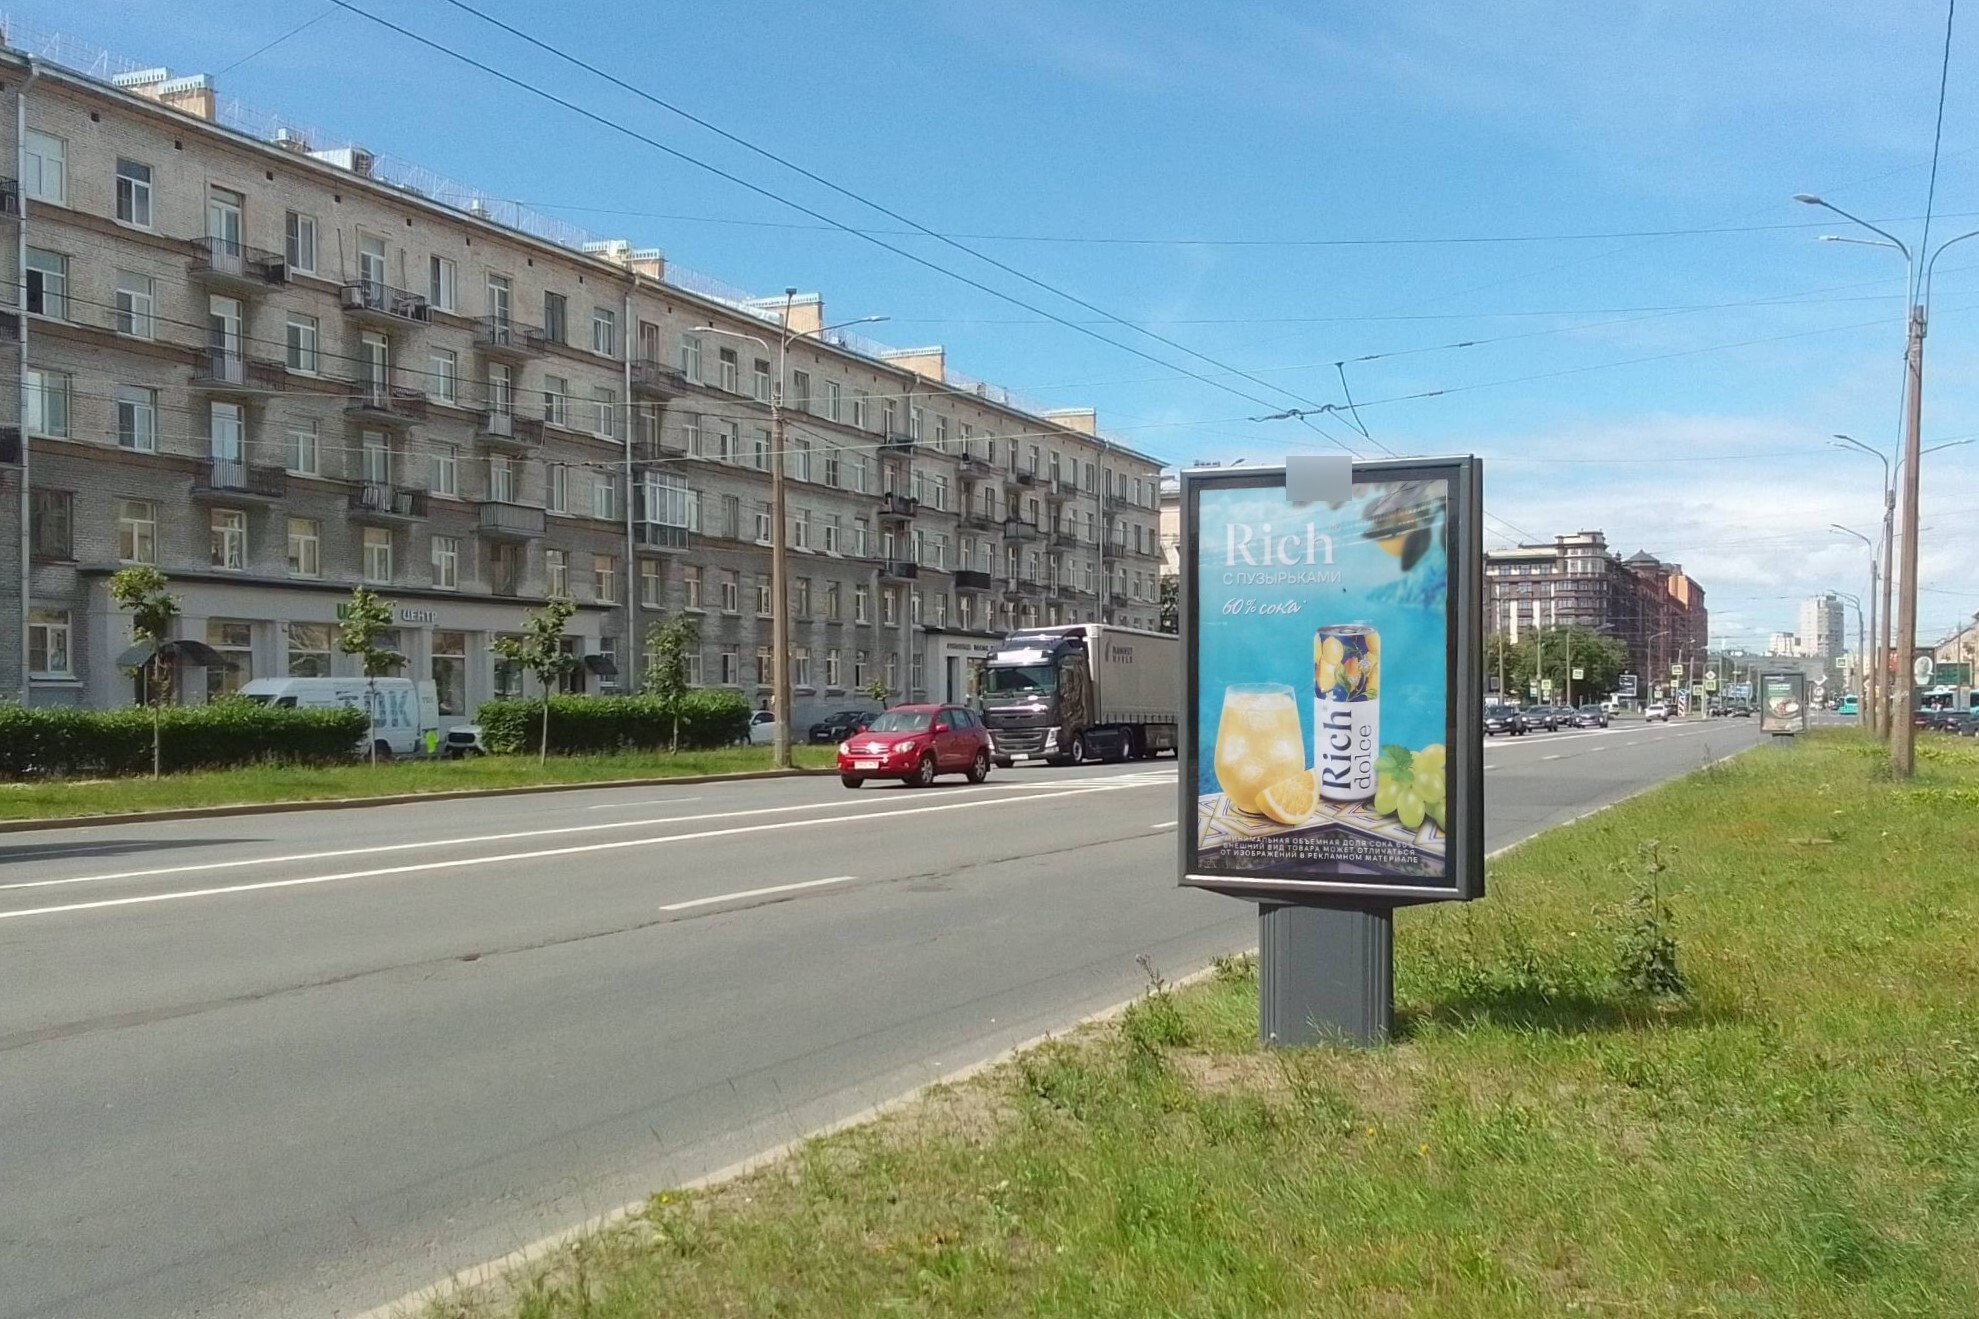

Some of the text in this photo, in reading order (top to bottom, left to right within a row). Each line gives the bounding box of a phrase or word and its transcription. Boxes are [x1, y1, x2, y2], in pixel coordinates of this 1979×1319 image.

[1225, 522, 1334, 566] Rich
[1223, 571, 1342, 585] С ПУЗЫРЬКАМИ
[1222, 598, 1257, 615] 60%
[1322, 711, 1352, 790] Rich
[1354, 725, 1372, 790] dolce
[1223, 842, 1265, 850] ВНЕШНИЙ
[1322, 845, 1354, 853] МОЖЕТ
[1358, 846, 1415, 856] ОТЛИЧАТЬСЯ
[1342, 839, 1367, 848] ДОЛЯ
[1369, 840, 1393, 848] СОКА
[1233, 850, 1297, 858] ИЗОБРАЖЕНИЙ
[1307, 852, 1363, 861] РЕКЛАМНОМ
[1365, 854, 1419, 863] МАТЕРИАЛЕ
